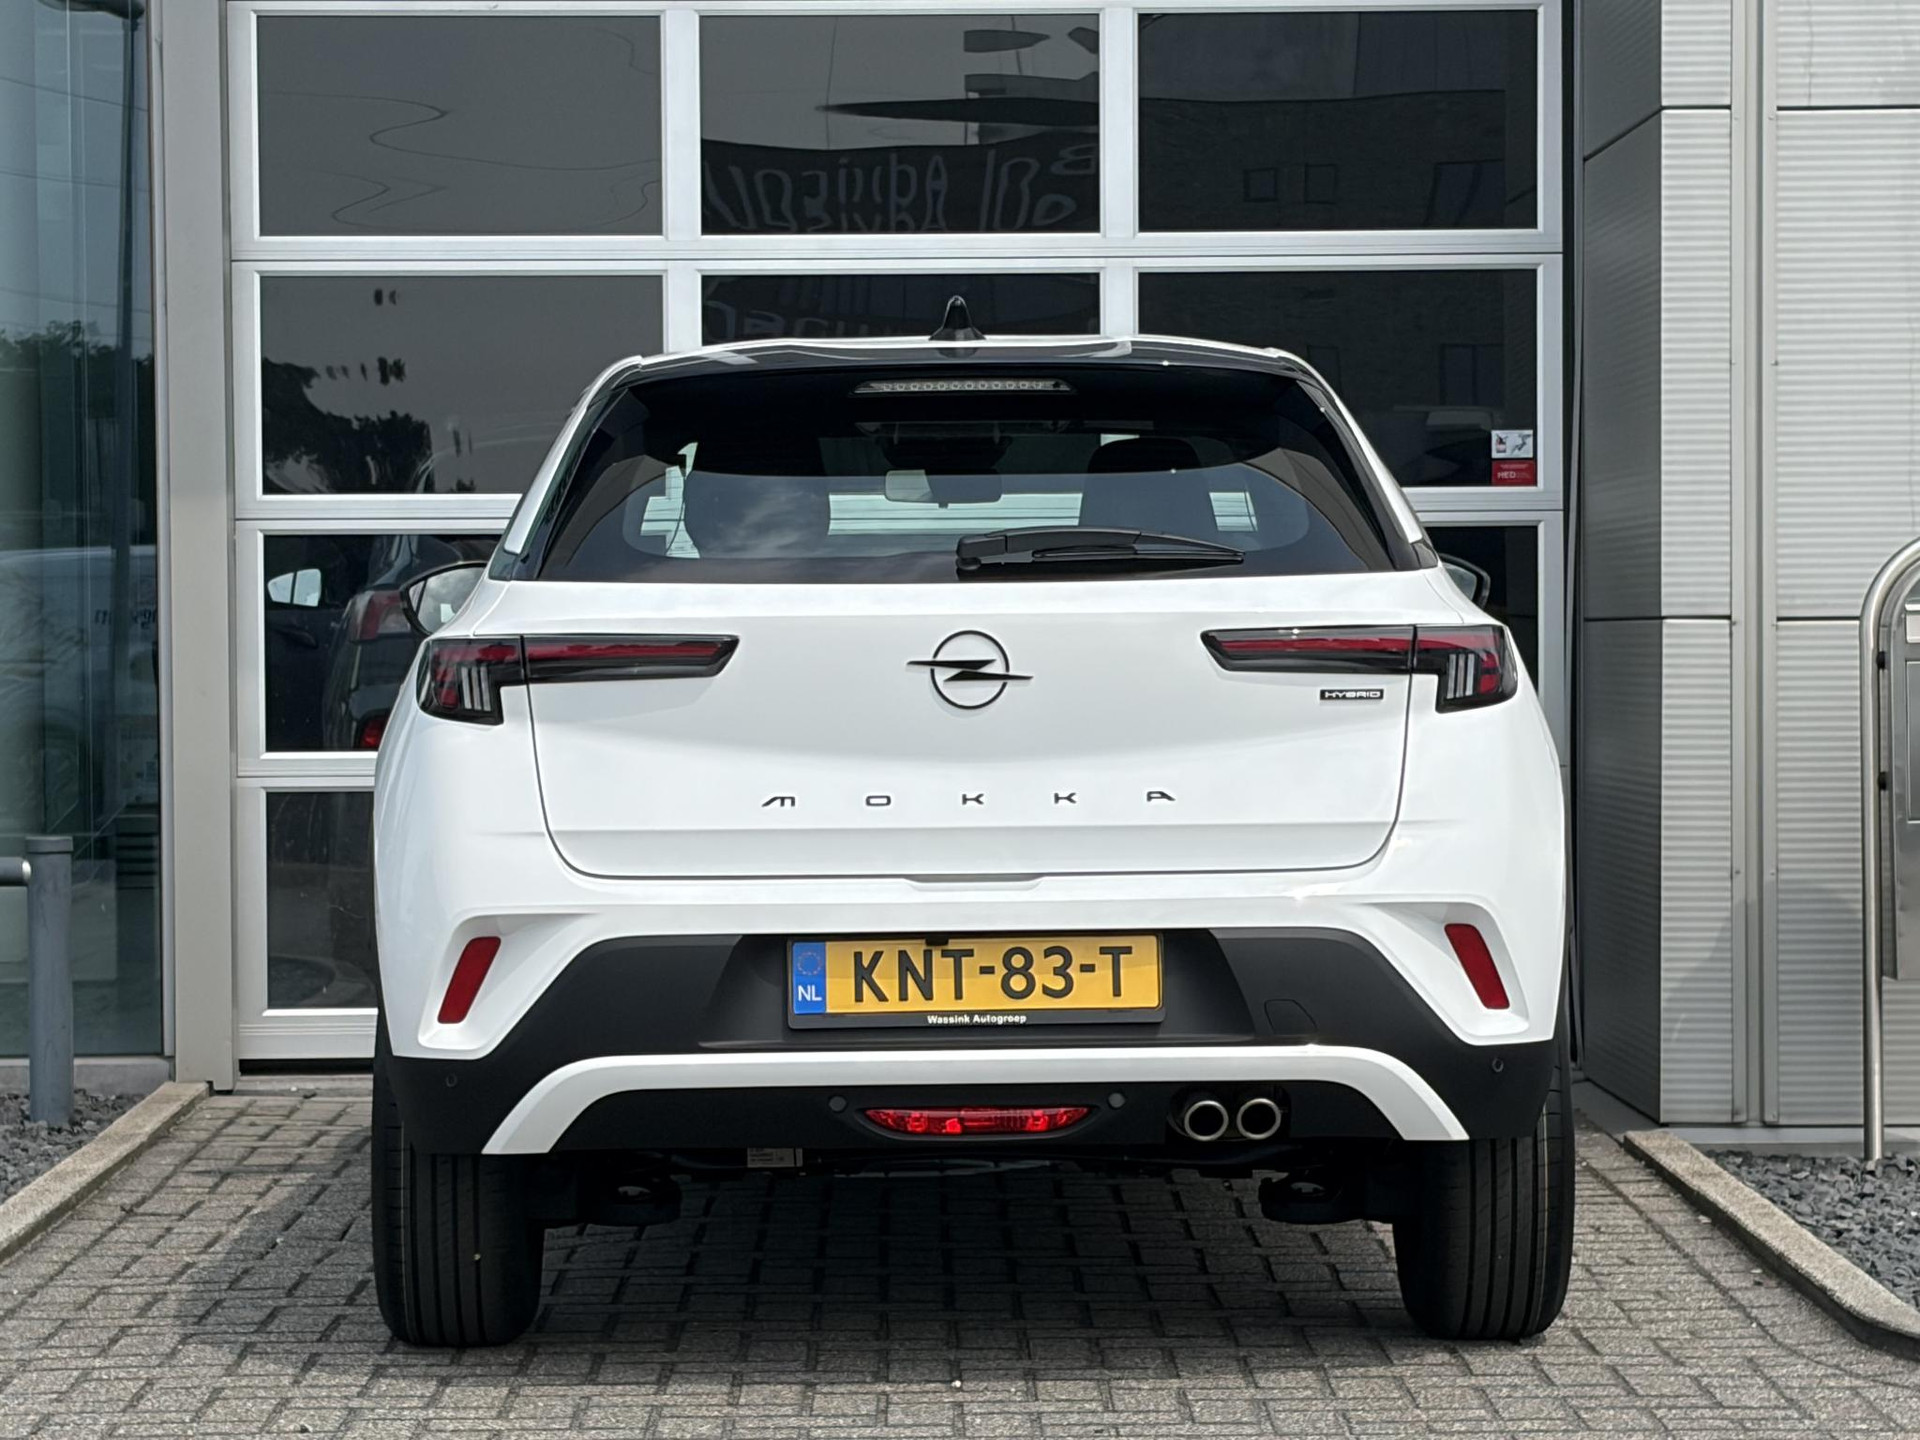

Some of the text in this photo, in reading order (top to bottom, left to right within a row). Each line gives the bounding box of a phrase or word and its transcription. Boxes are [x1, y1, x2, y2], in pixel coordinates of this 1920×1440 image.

[1324, 690, 1381, 699] HYBRID
[762, 790, 1175, 807] MOKKA
[853, 946, 1133, 1003] KNT-83-T
[798, 985, 823, 1001] NL
[927, 1014, 1027, 1025] Wassink Autogroep
